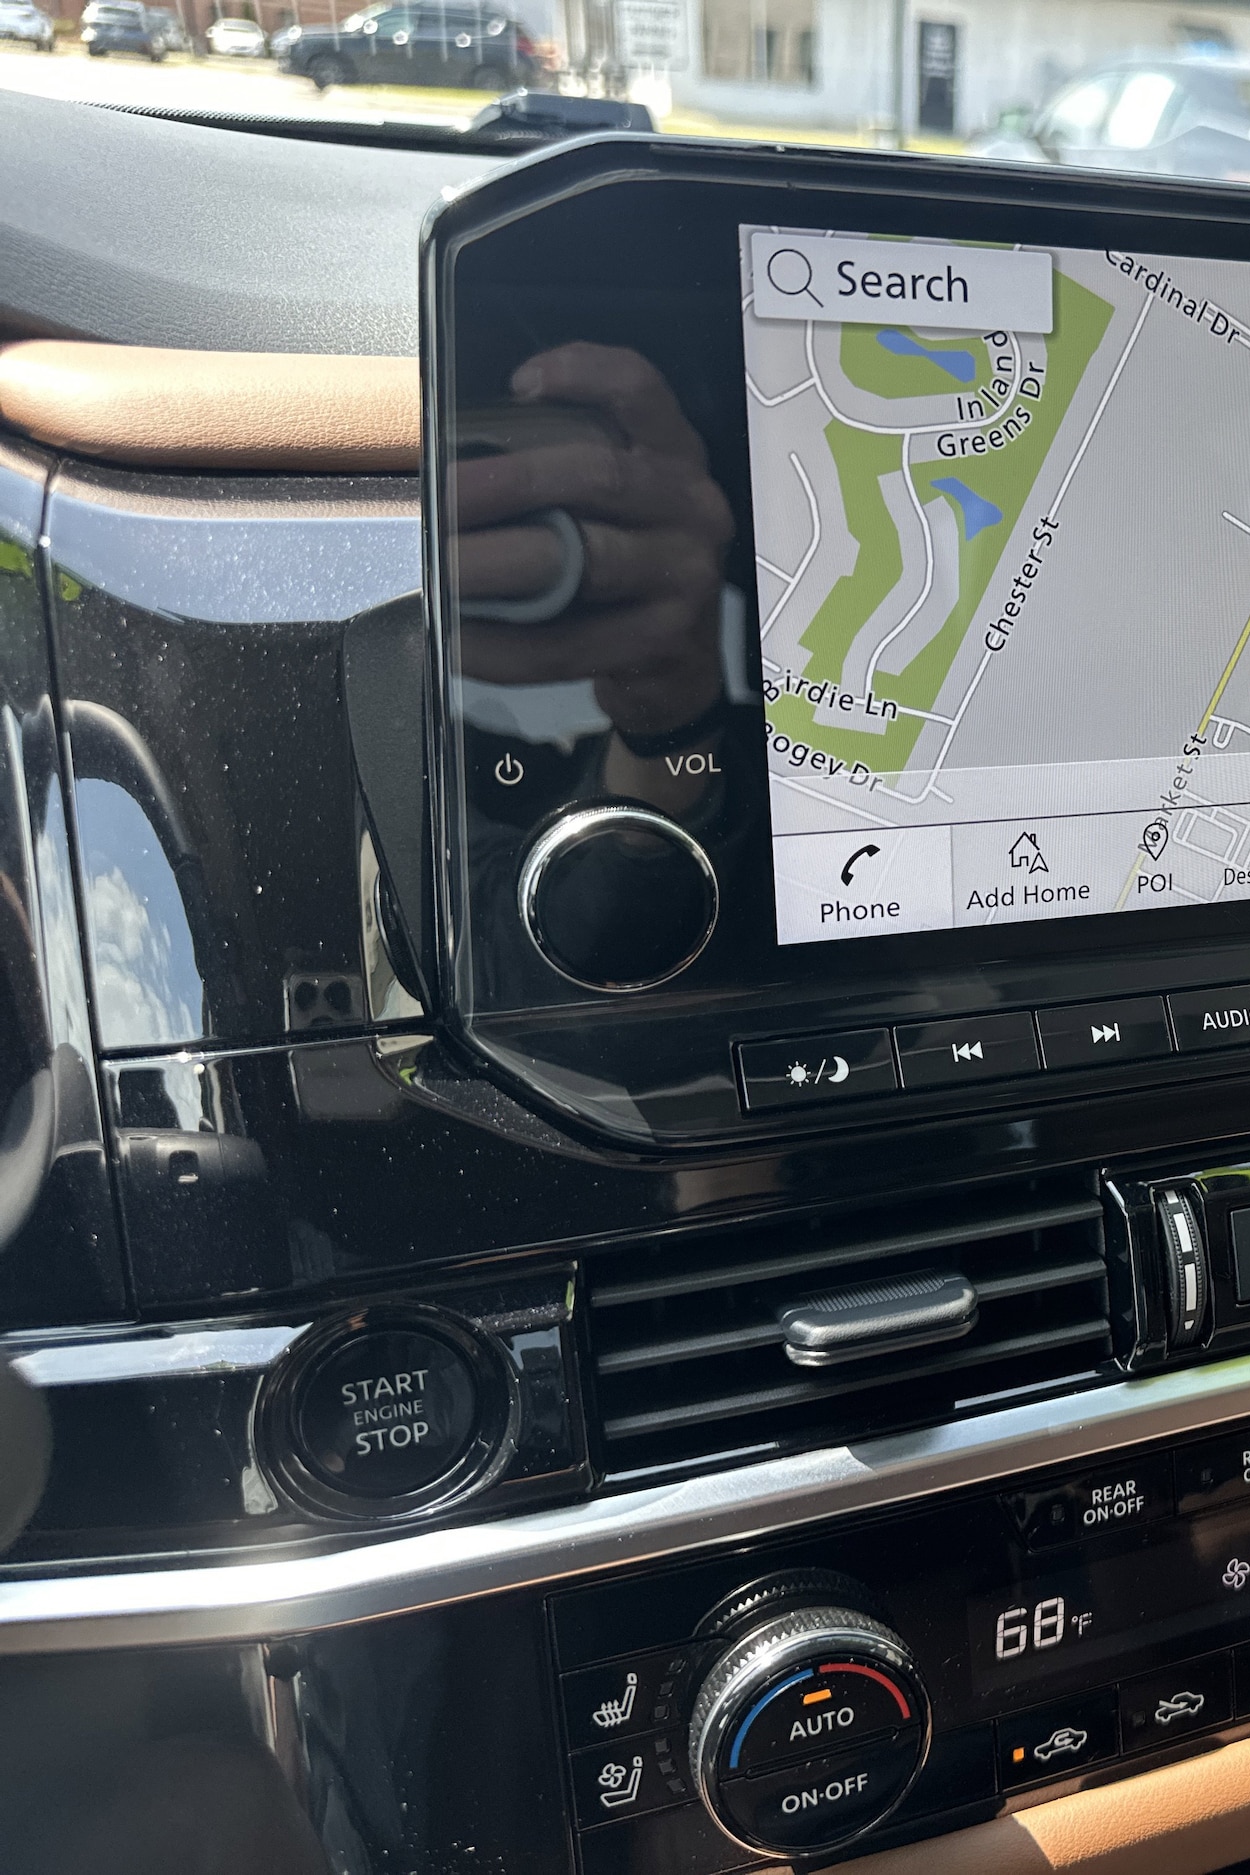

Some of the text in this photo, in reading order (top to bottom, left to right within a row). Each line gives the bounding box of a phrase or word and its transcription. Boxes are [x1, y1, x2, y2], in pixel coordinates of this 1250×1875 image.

[837, 260, 969, 303] Search
[1106, 249, 1240, 345] Cardinal Dr
[957, 330, 1014, 421] Inland
[937, 361, 1045, 456] Greens Dr
[985, 516, 1060, 652] Chester St
[763, 669, 897, 719] Birdie Ln
[665, 752, 722, 777] VOL
[848, 763, 883, 792] Dr
[1137, 733, 1208, 856] Market St
[966, 884, 1091, 911] Add Home
[1137, 873, 1173, 894] POI
[820, 900, 901, 924] Phone
[340, 1368, 429, 1406] START
[353, 1399, 424, 1426] ENGINE
[354, 1421, 430, 1456] STOP
[1091, 1479, 1137, 1506] REAR
[788, 1706, 855, 1742] AUTO
